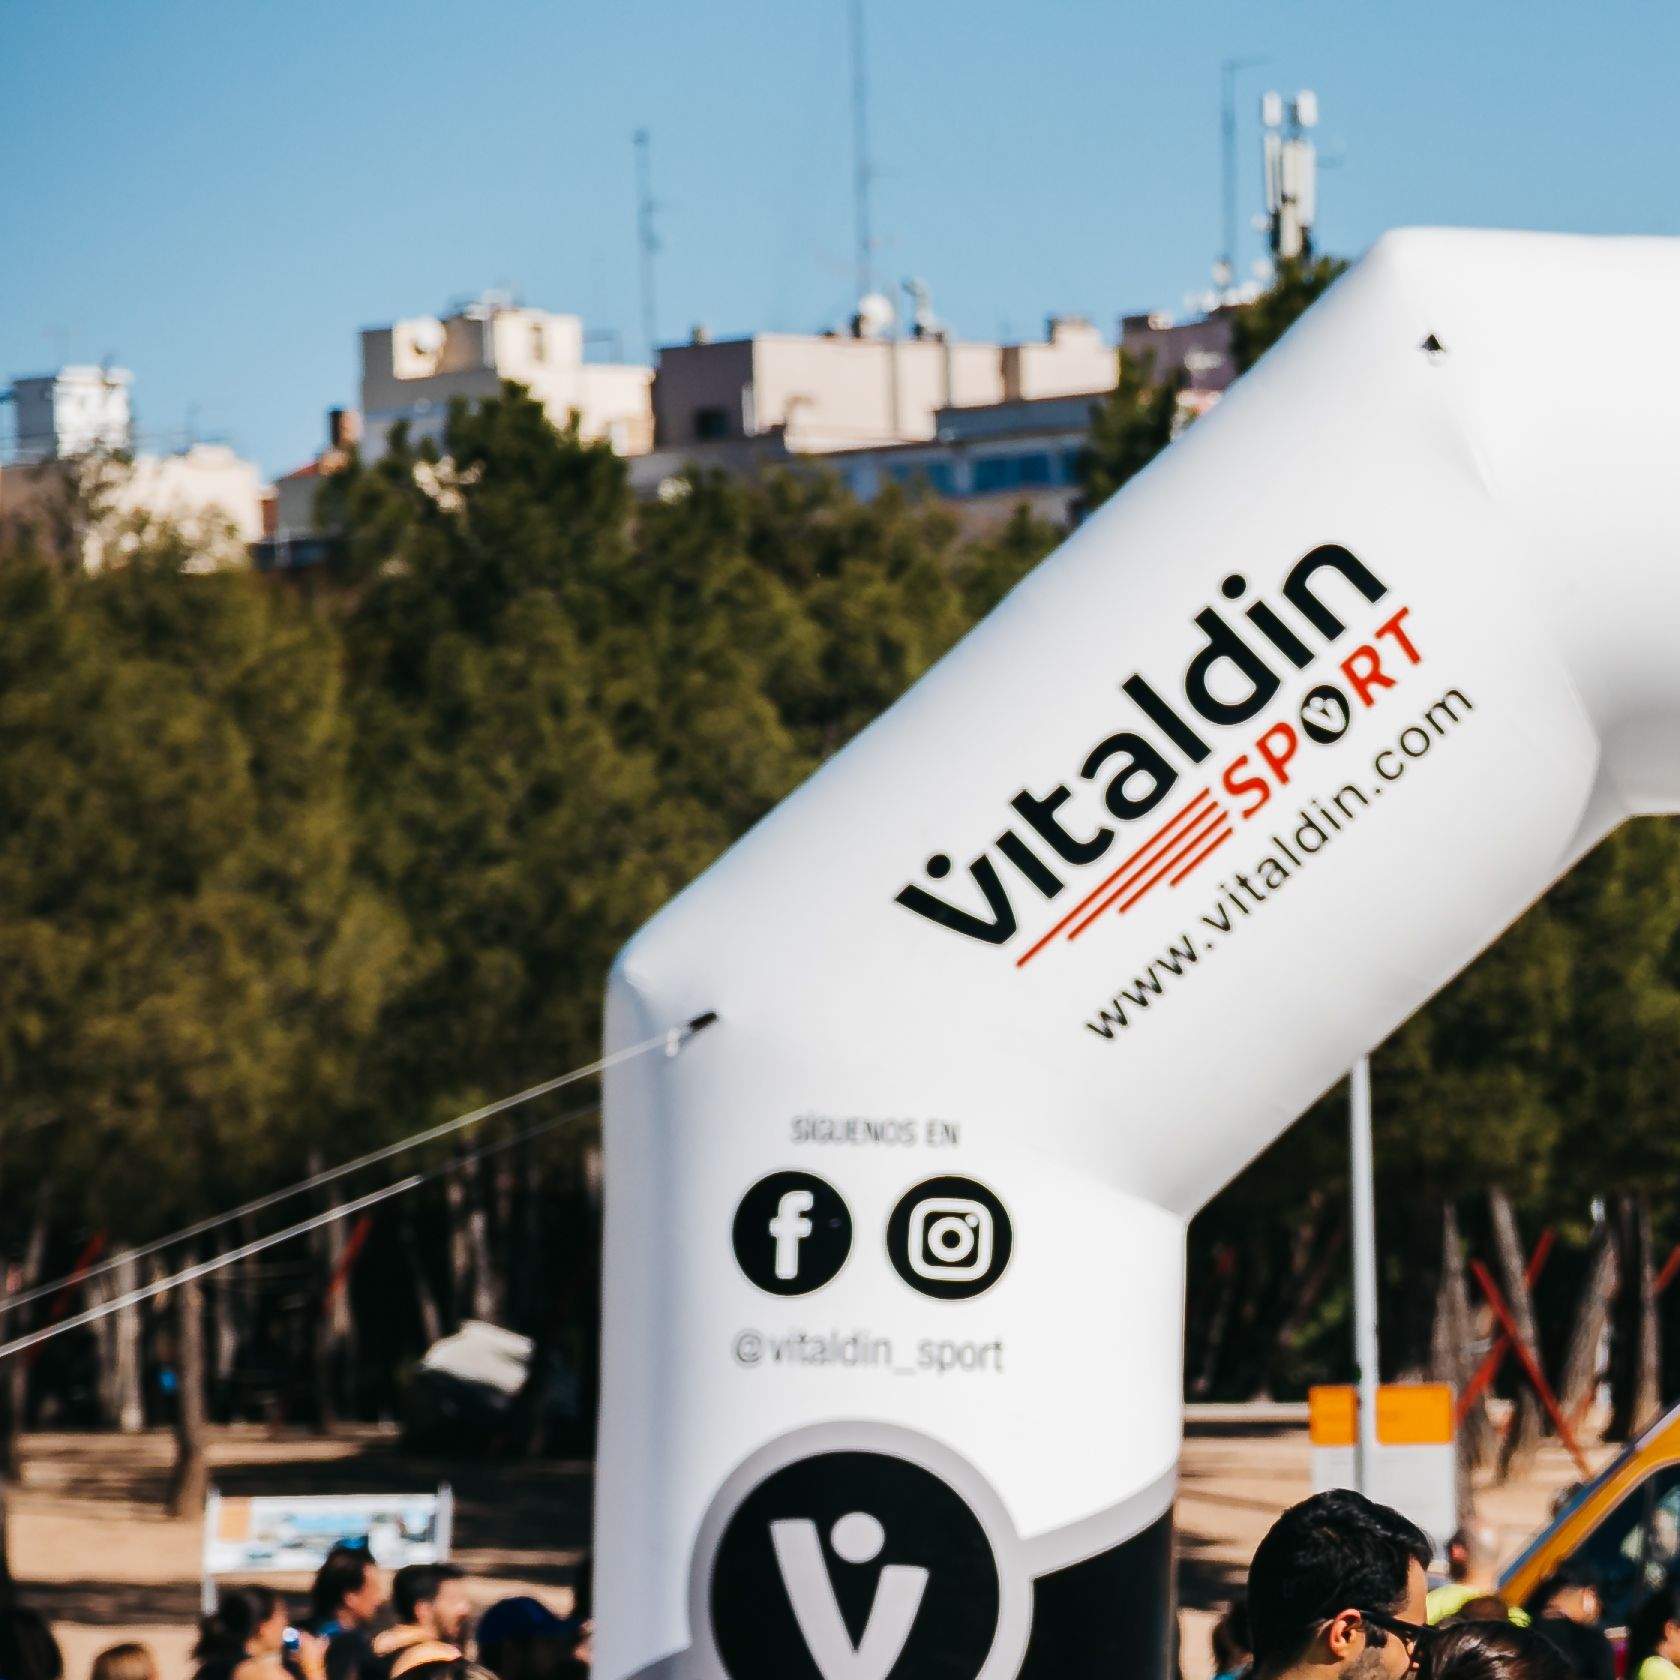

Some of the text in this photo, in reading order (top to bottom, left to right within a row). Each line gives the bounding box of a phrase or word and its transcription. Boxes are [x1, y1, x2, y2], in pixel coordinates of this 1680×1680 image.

[894, 543, 1390, 945] Vitaldin
[1222, 606, 1422, 821] SPORT
[1085, 686, 1474, 1041] www.vitaldin.com
[924, 1118, 960, 1148] EN
[732, 1330, 1006, 1375] @vitaldin_sport
